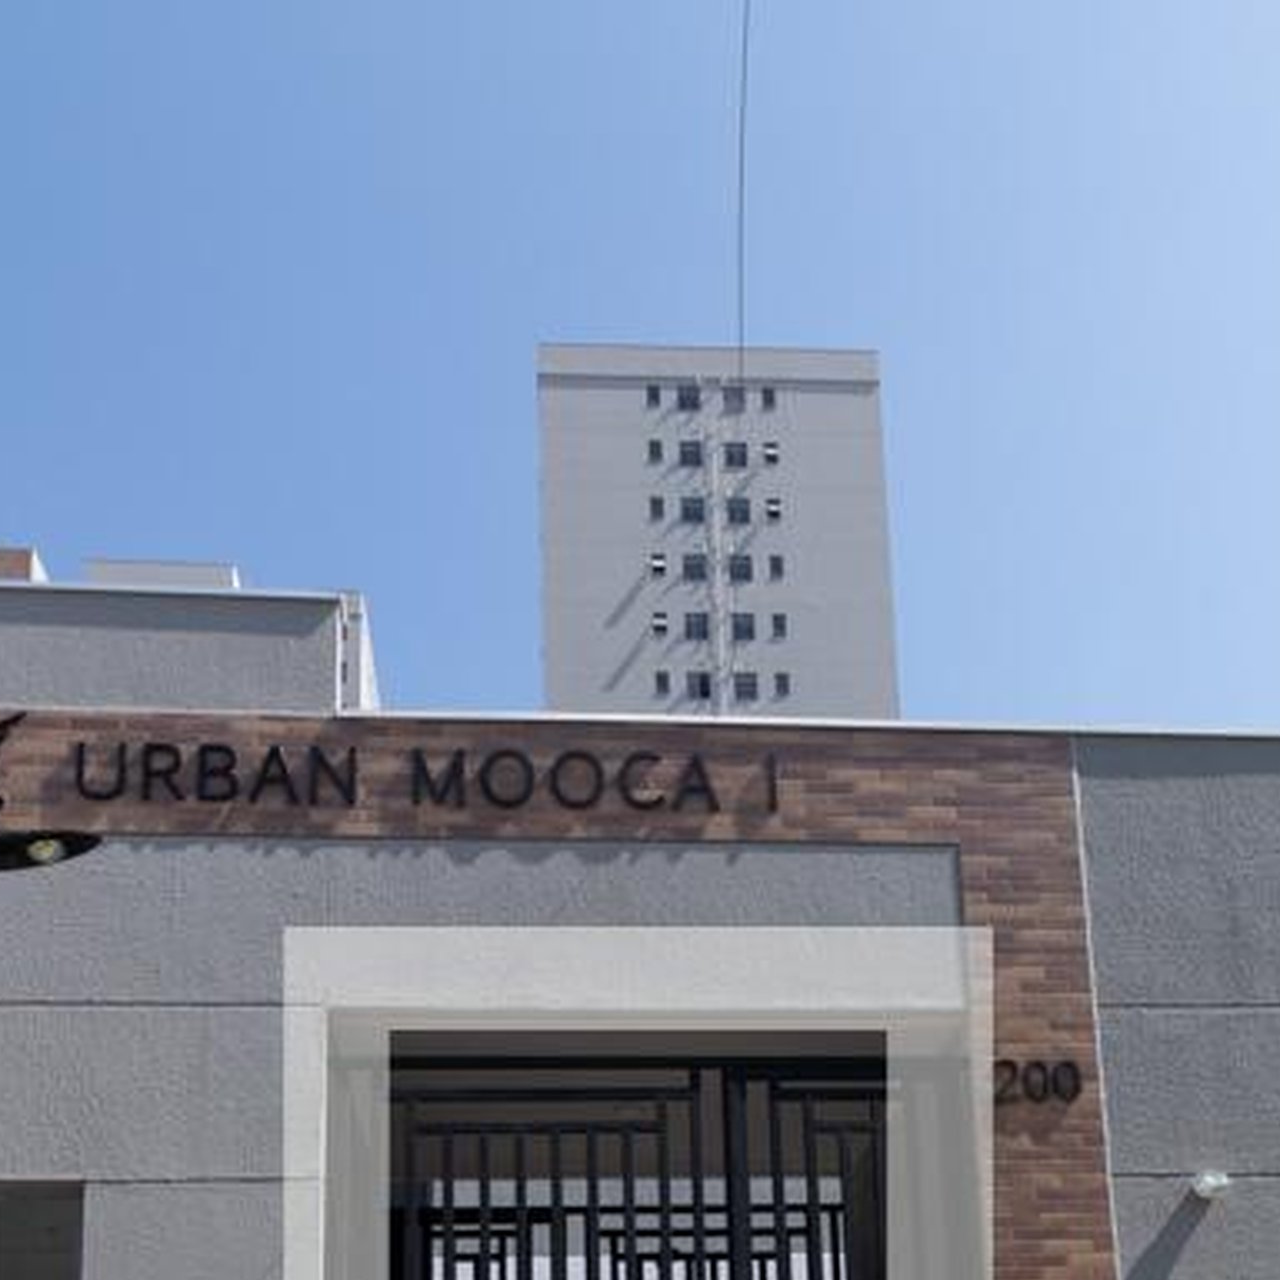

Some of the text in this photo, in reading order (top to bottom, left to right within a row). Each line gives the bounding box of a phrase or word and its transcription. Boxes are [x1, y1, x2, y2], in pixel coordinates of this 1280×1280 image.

[75, 742, 779, 813] URBAN MOOCA I
[992, 1059, 1080, 1103] 200
